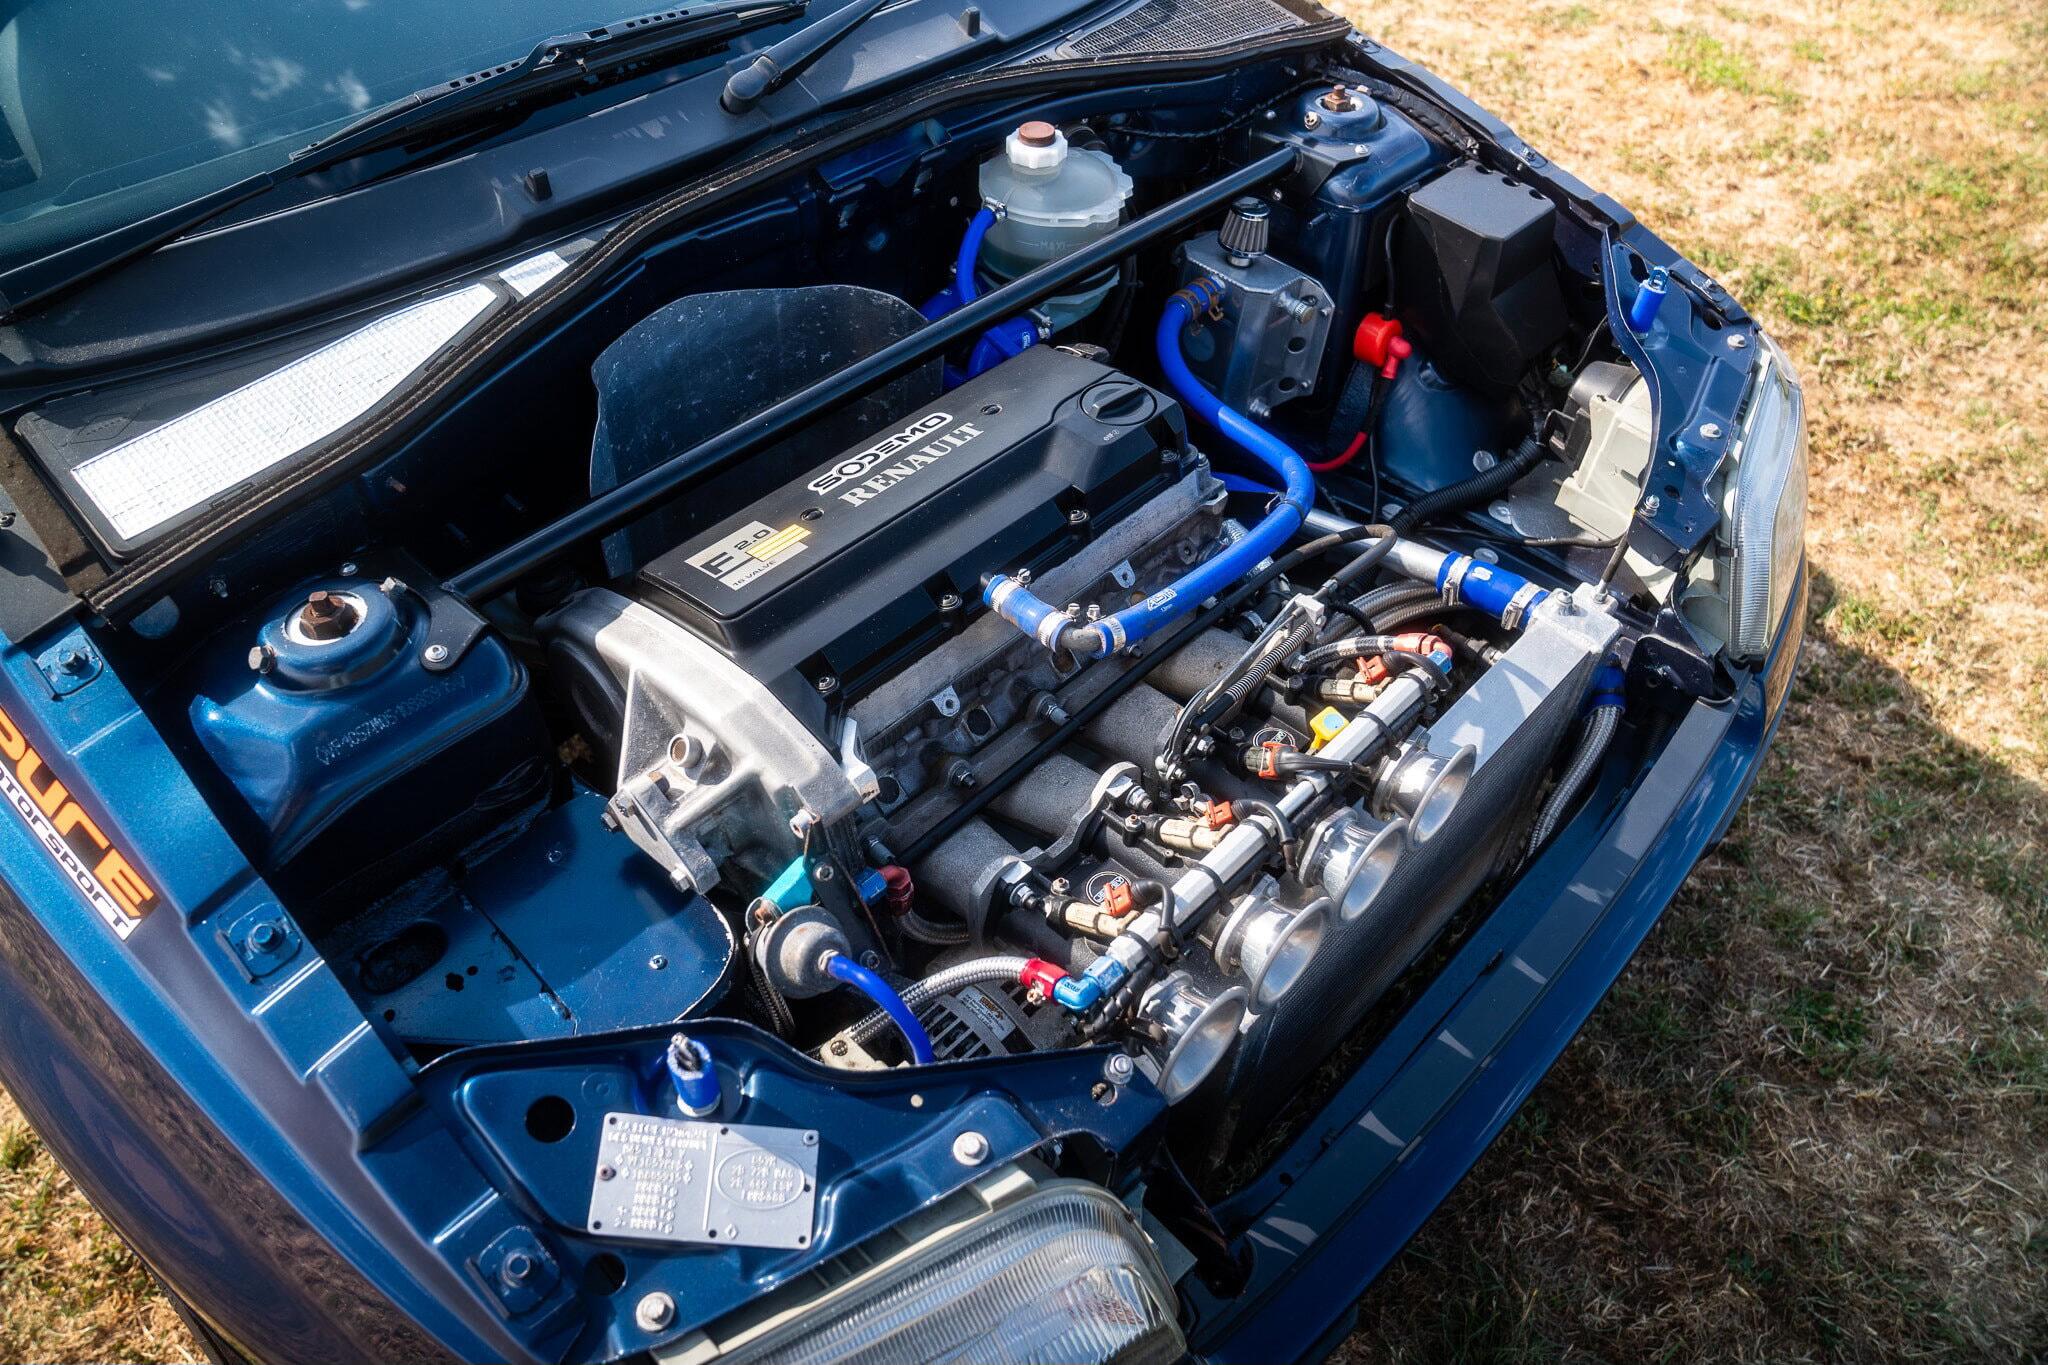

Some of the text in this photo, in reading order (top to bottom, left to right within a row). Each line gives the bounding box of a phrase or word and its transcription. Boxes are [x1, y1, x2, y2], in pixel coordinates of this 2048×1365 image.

[809, 413, 952, 494] SODEMO
[838, 422, 985, 507] RENAULT
[733, 529, 771, 551] 2.0
